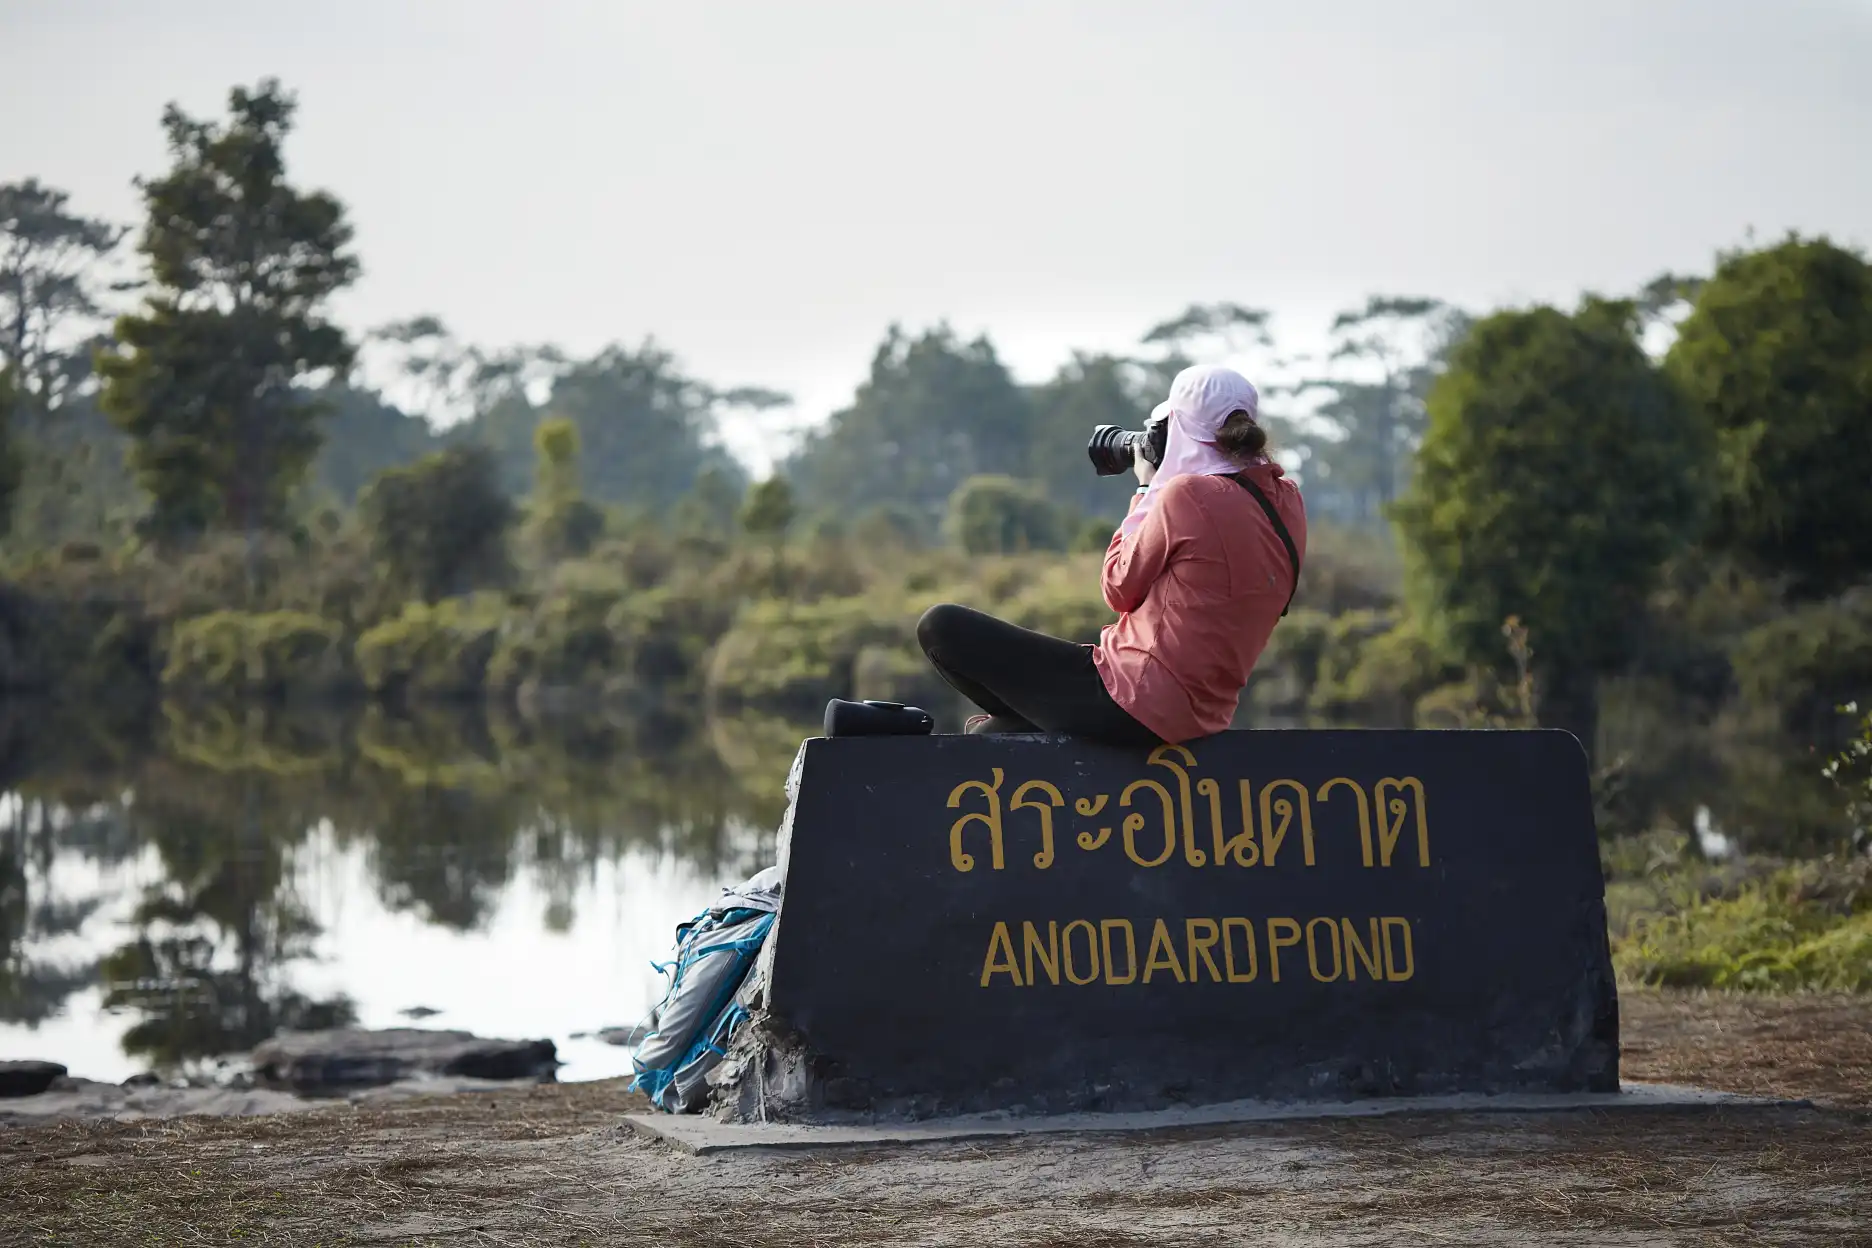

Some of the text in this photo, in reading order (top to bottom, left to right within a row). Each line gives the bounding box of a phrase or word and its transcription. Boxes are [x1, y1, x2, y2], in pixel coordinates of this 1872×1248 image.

[947, 744, 1430, 872] สระอโนดาต
[980, 916, 1415, 987] ANODARD POND
